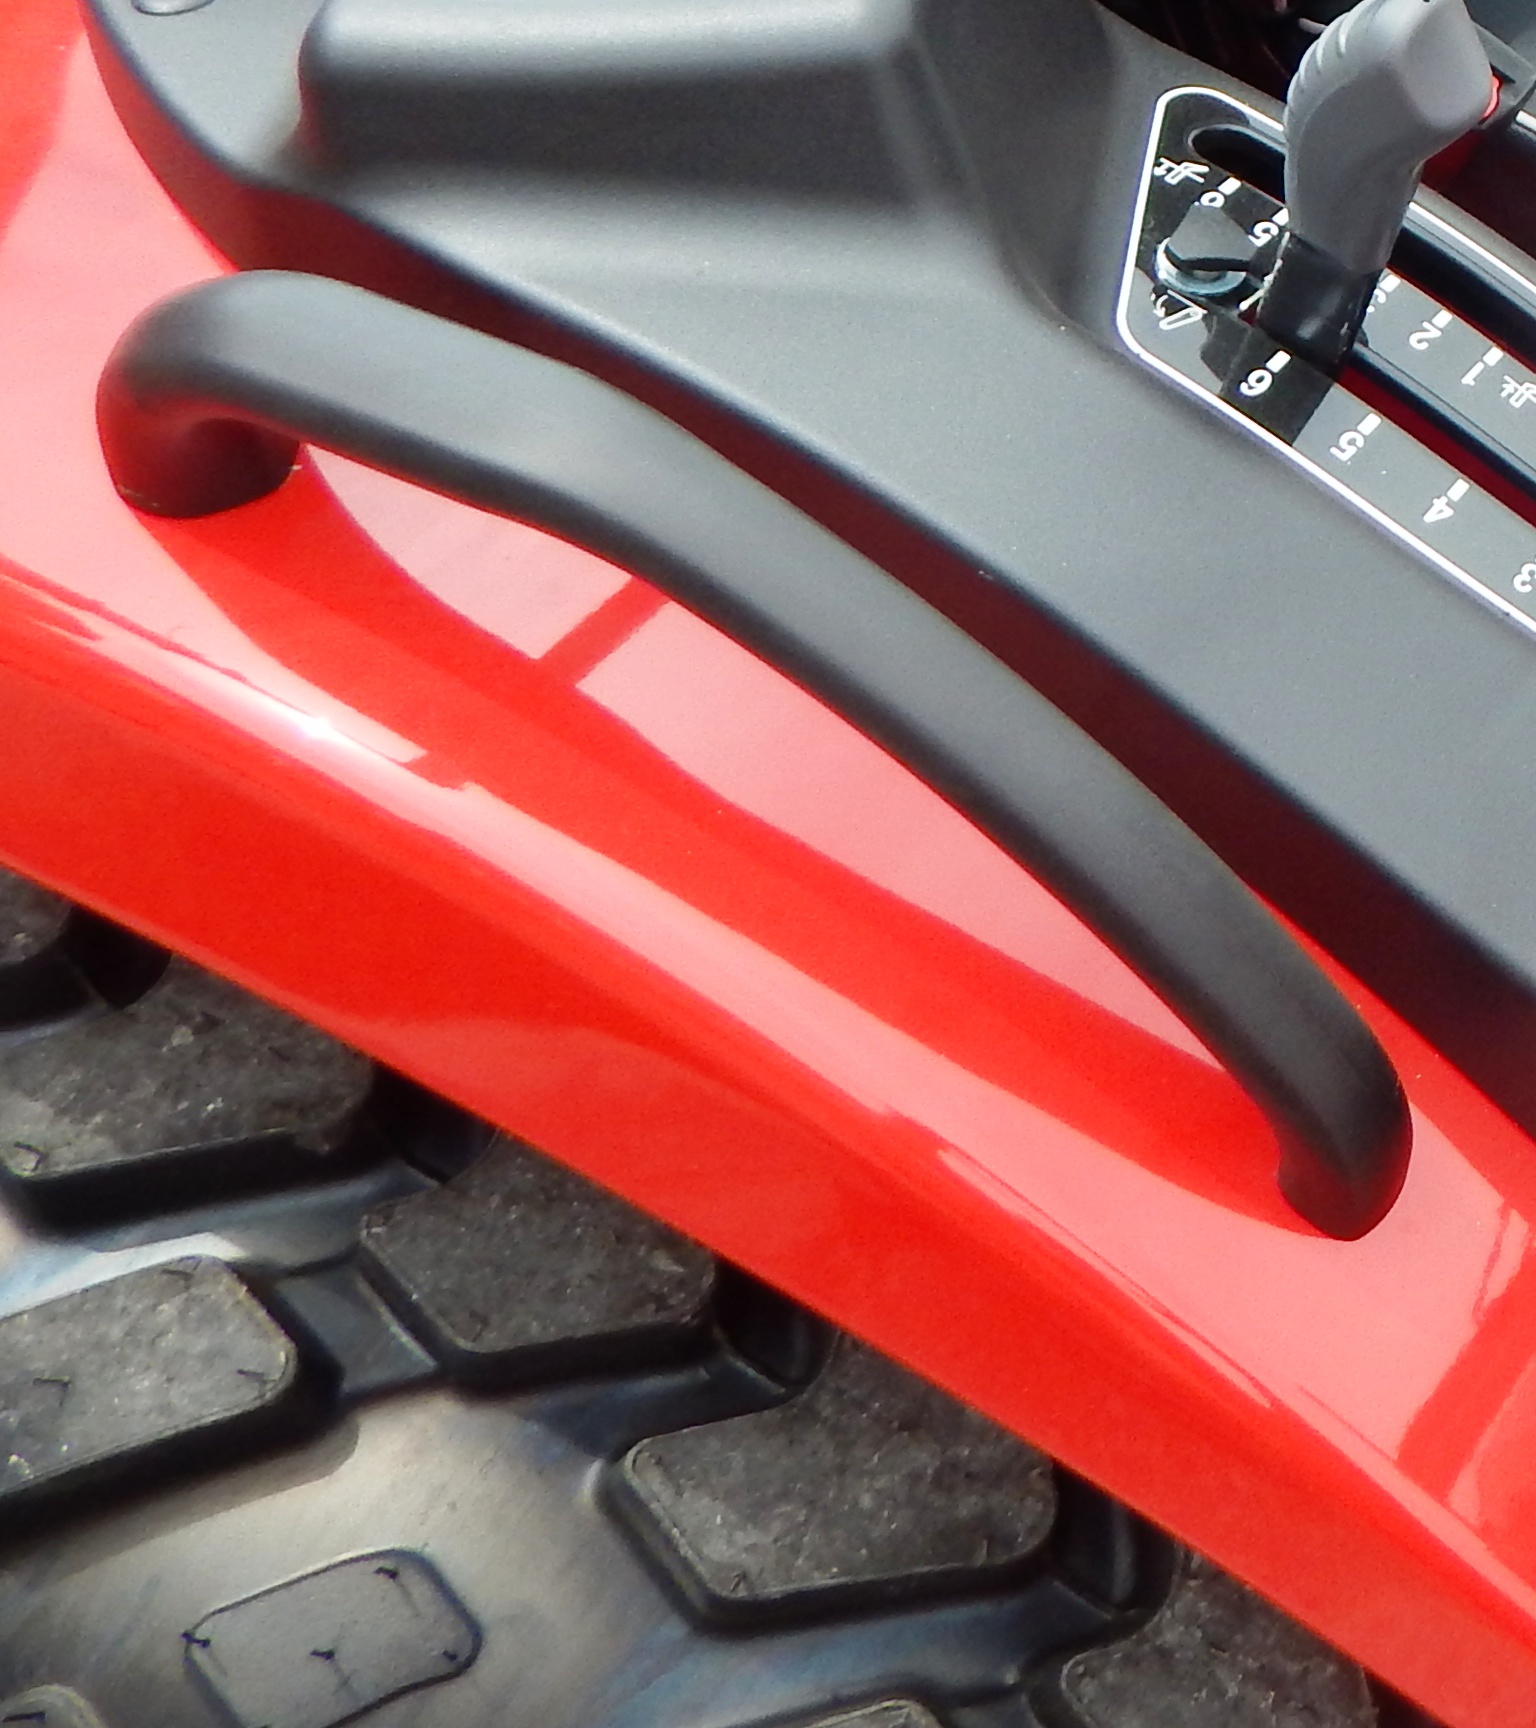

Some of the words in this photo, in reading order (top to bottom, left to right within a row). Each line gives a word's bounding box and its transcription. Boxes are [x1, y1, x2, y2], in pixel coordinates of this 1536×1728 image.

[1247, 220, 1279, 248] 5
[1408, 320, 1442, 350] 2
[1240, 368, 1273, 397] 6
[1461, 361, 1485, 387] 1
[1330, 430, 1365, 462] 5
[1422, 495, 1455, 524] 4
